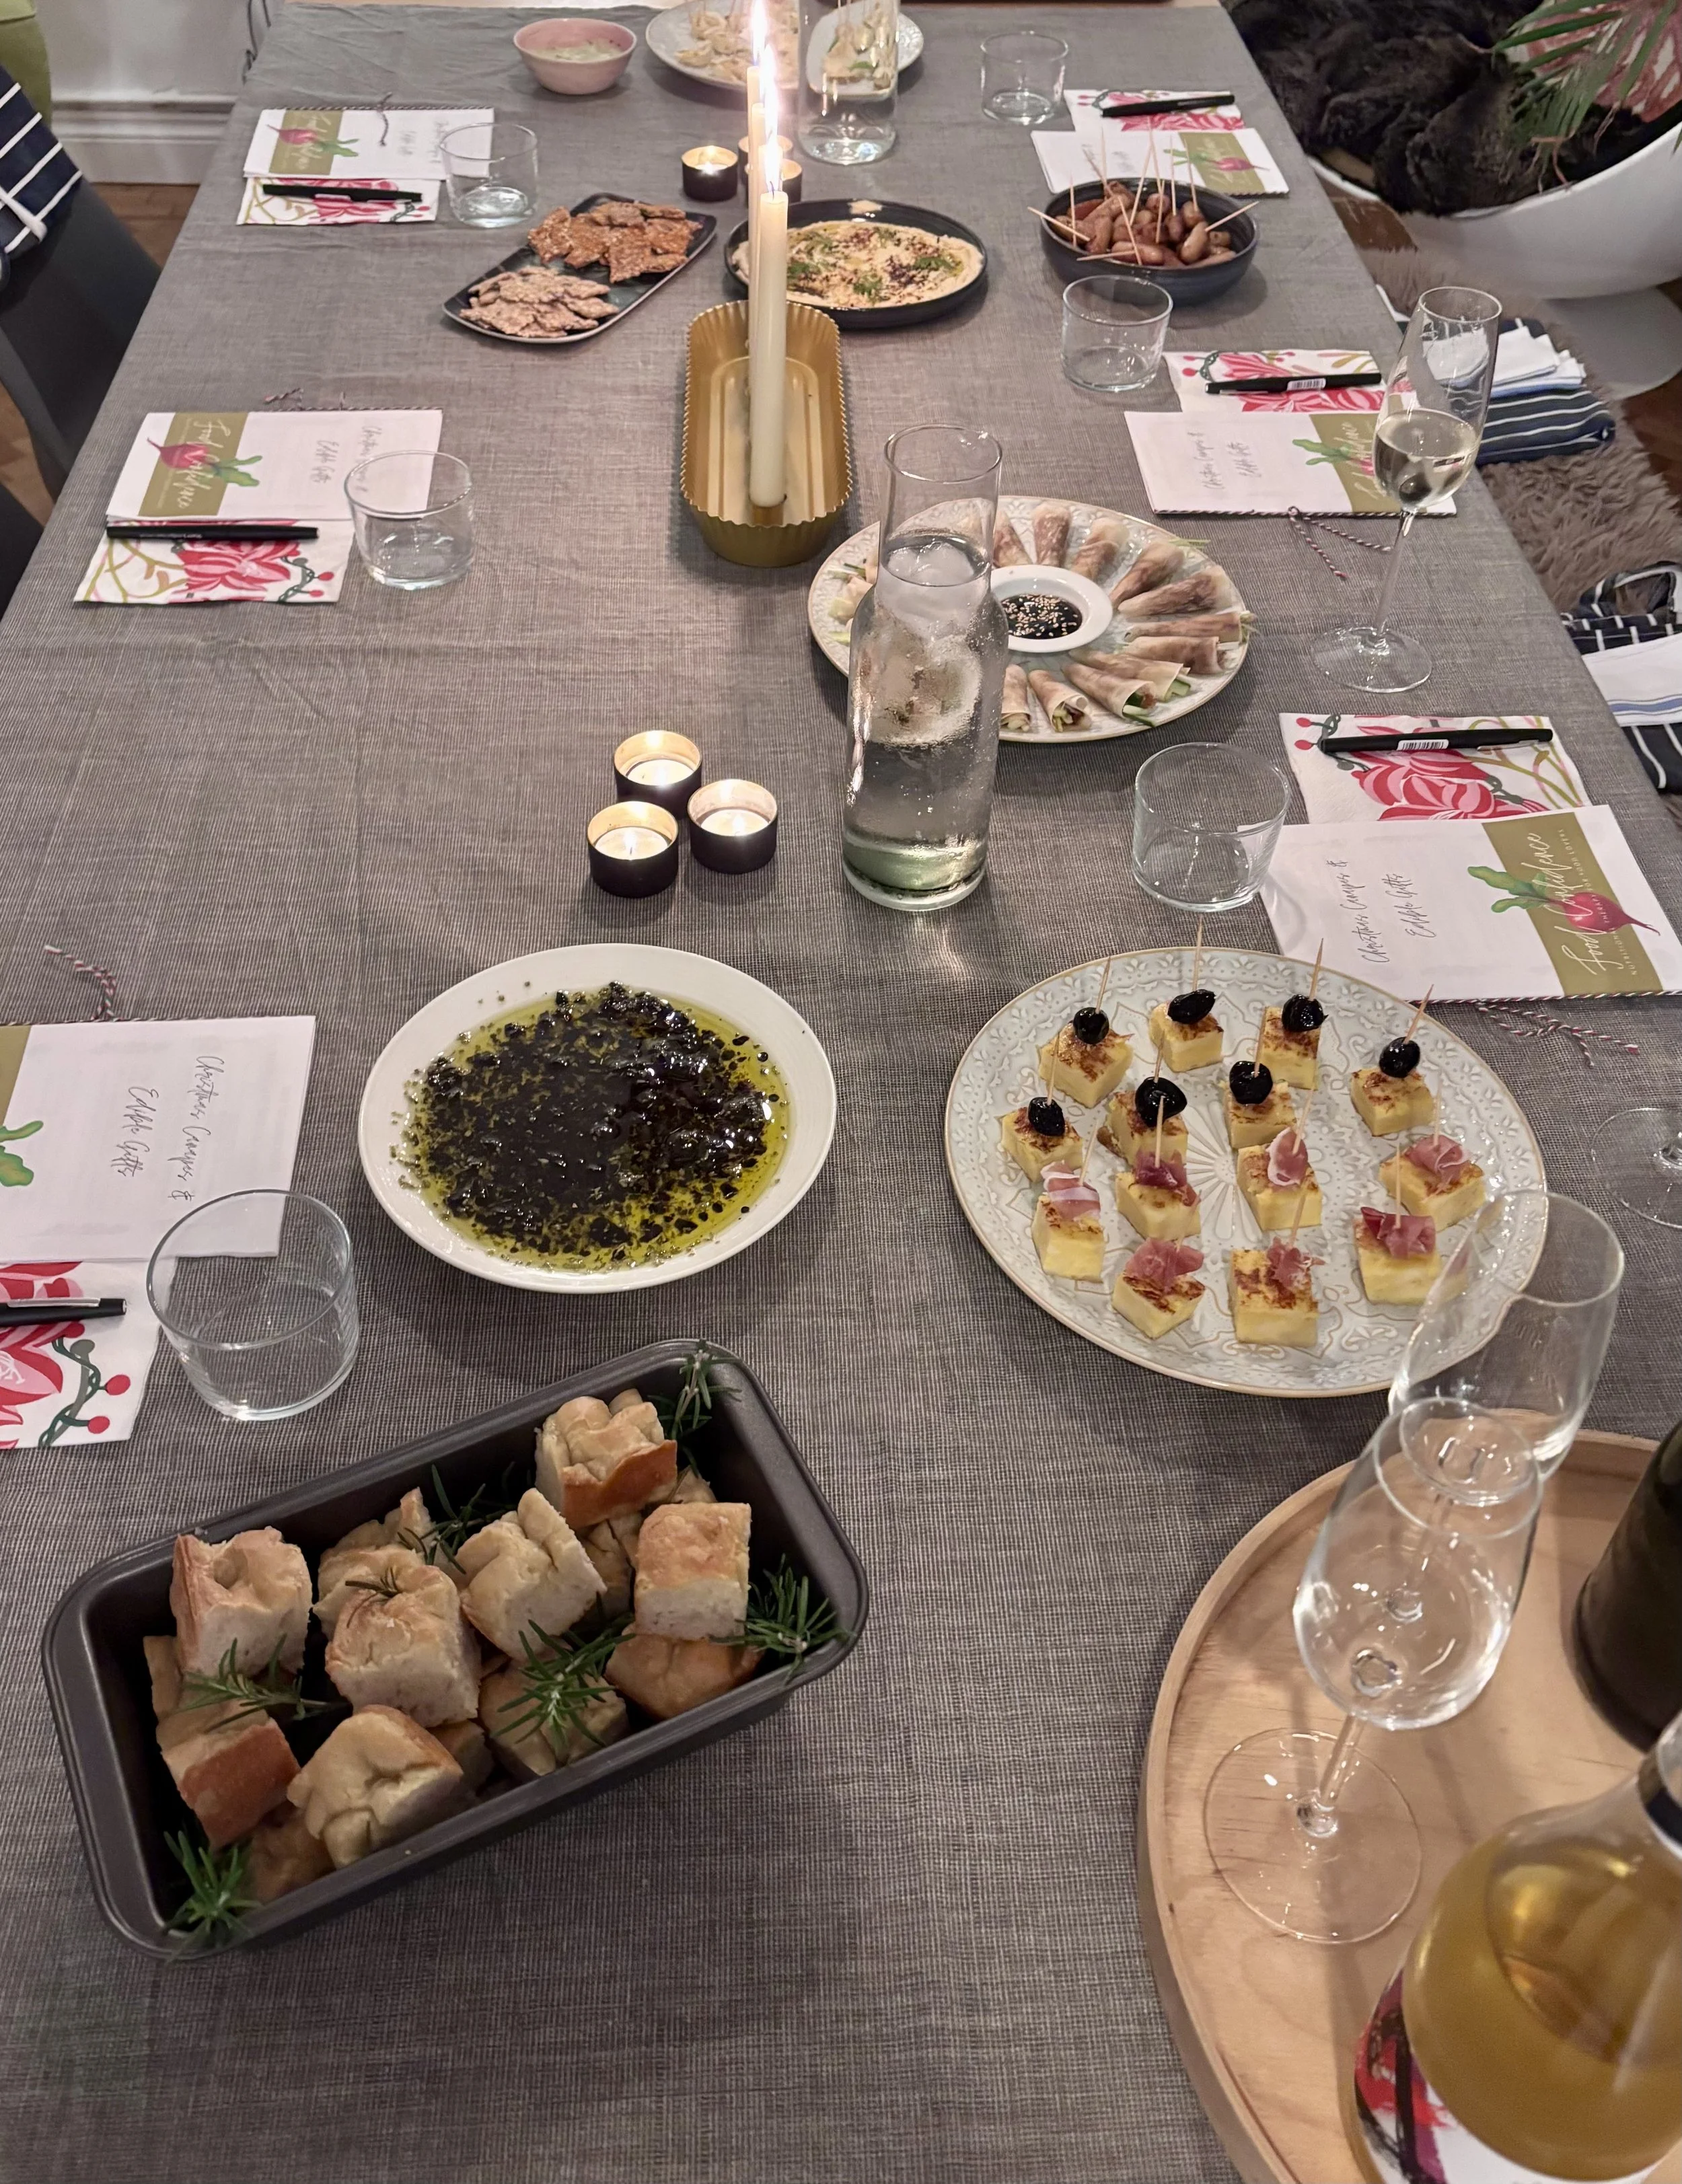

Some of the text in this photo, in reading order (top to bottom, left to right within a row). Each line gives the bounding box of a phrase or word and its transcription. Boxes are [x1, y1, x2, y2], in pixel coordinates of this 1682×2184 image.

[186, 418, 231, 447] Food
[1381, 873, 1436, 937] Edible Gifts
[1521, 832, 1624, 976] Food Confidence
[1351, 914, 1390, 963] Christmas
[187, 1056, 225, 1120] Christmas
[110, 1086, 159, 1177] Edible Gifts
[168, 1190, 195, 1202] &
